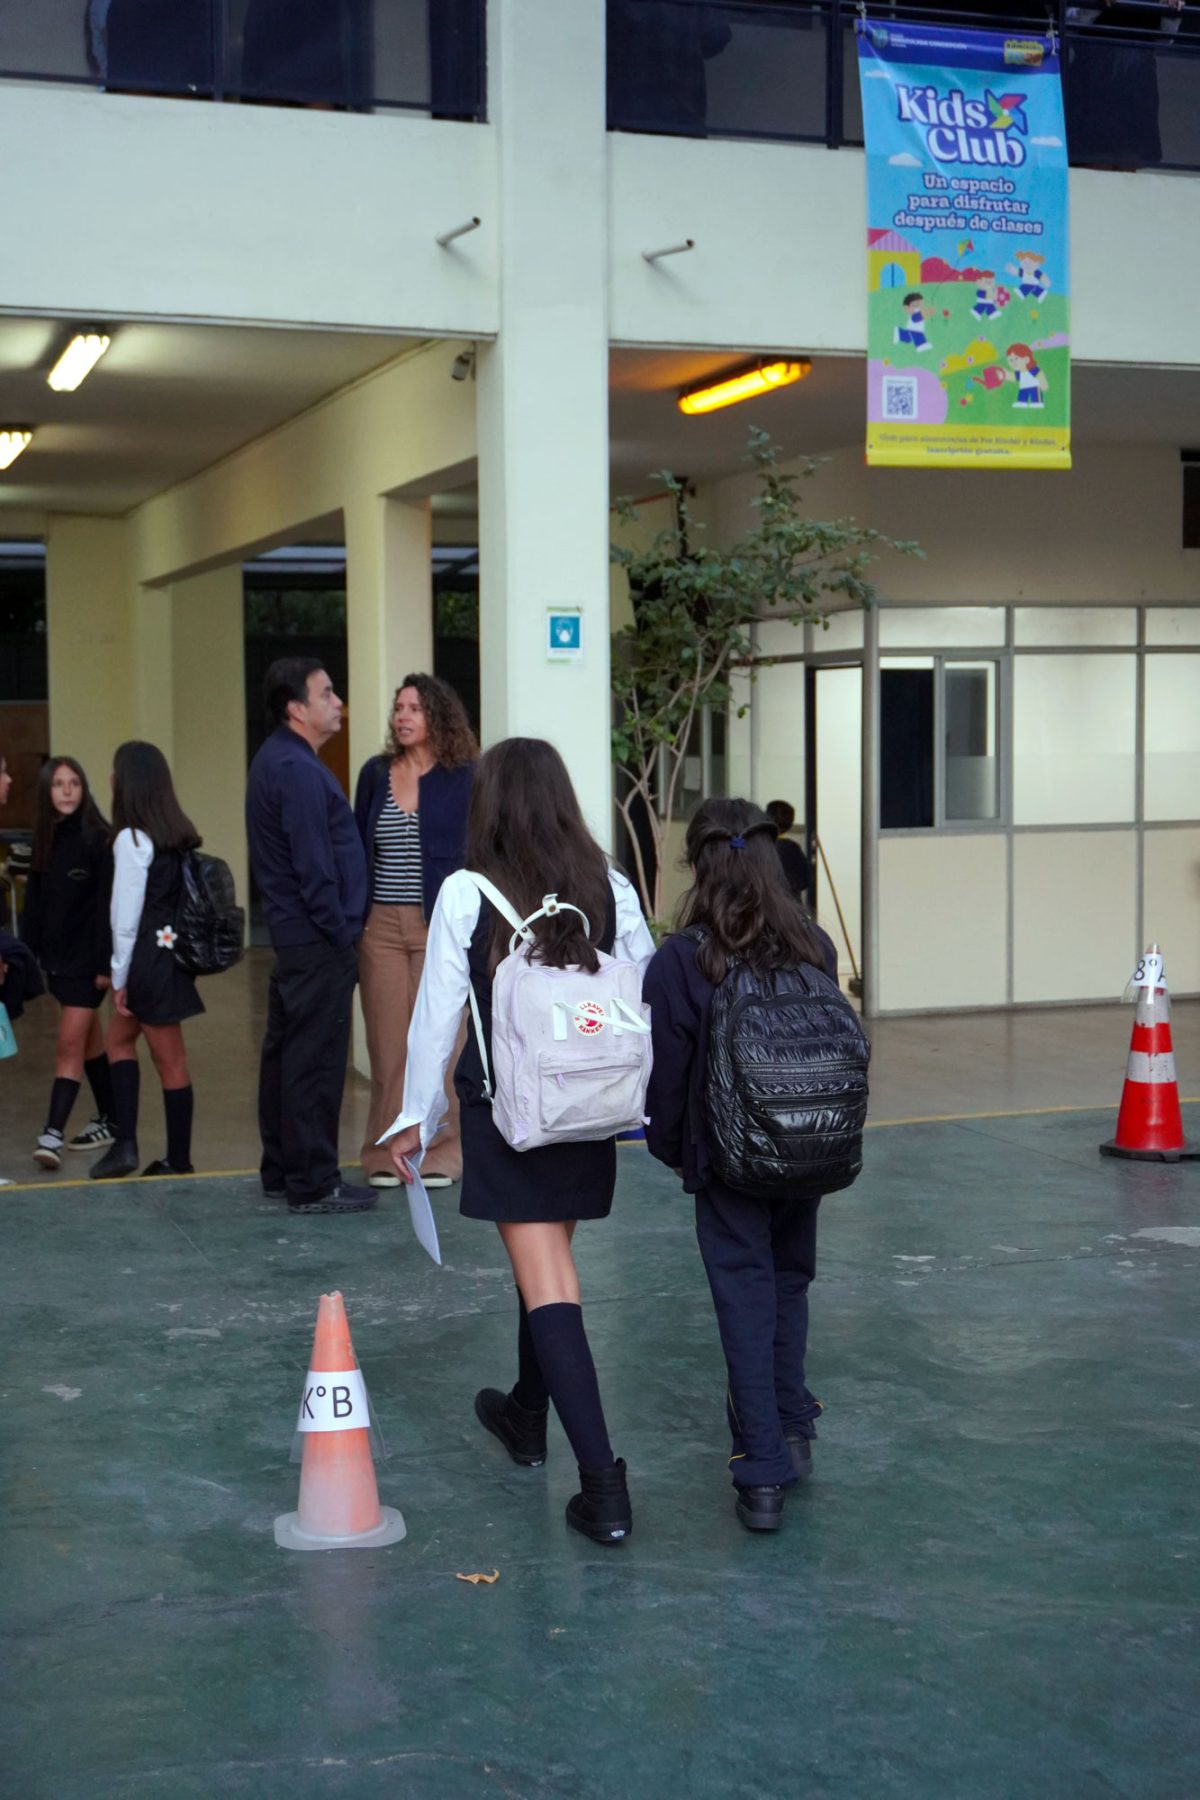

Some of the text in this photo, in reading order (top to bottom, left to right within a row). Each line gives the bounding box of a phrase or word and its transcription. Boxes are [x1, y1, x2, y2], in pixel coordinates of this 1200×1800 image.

[897, 85, 988, 129] Kids
[927, 128, 1025, 166] Club
[923, 174, 1015, 194] Un espacio
[908, 194, 1029, 214] para disfrutar
[894, 212, 1043, 234] después de clases
